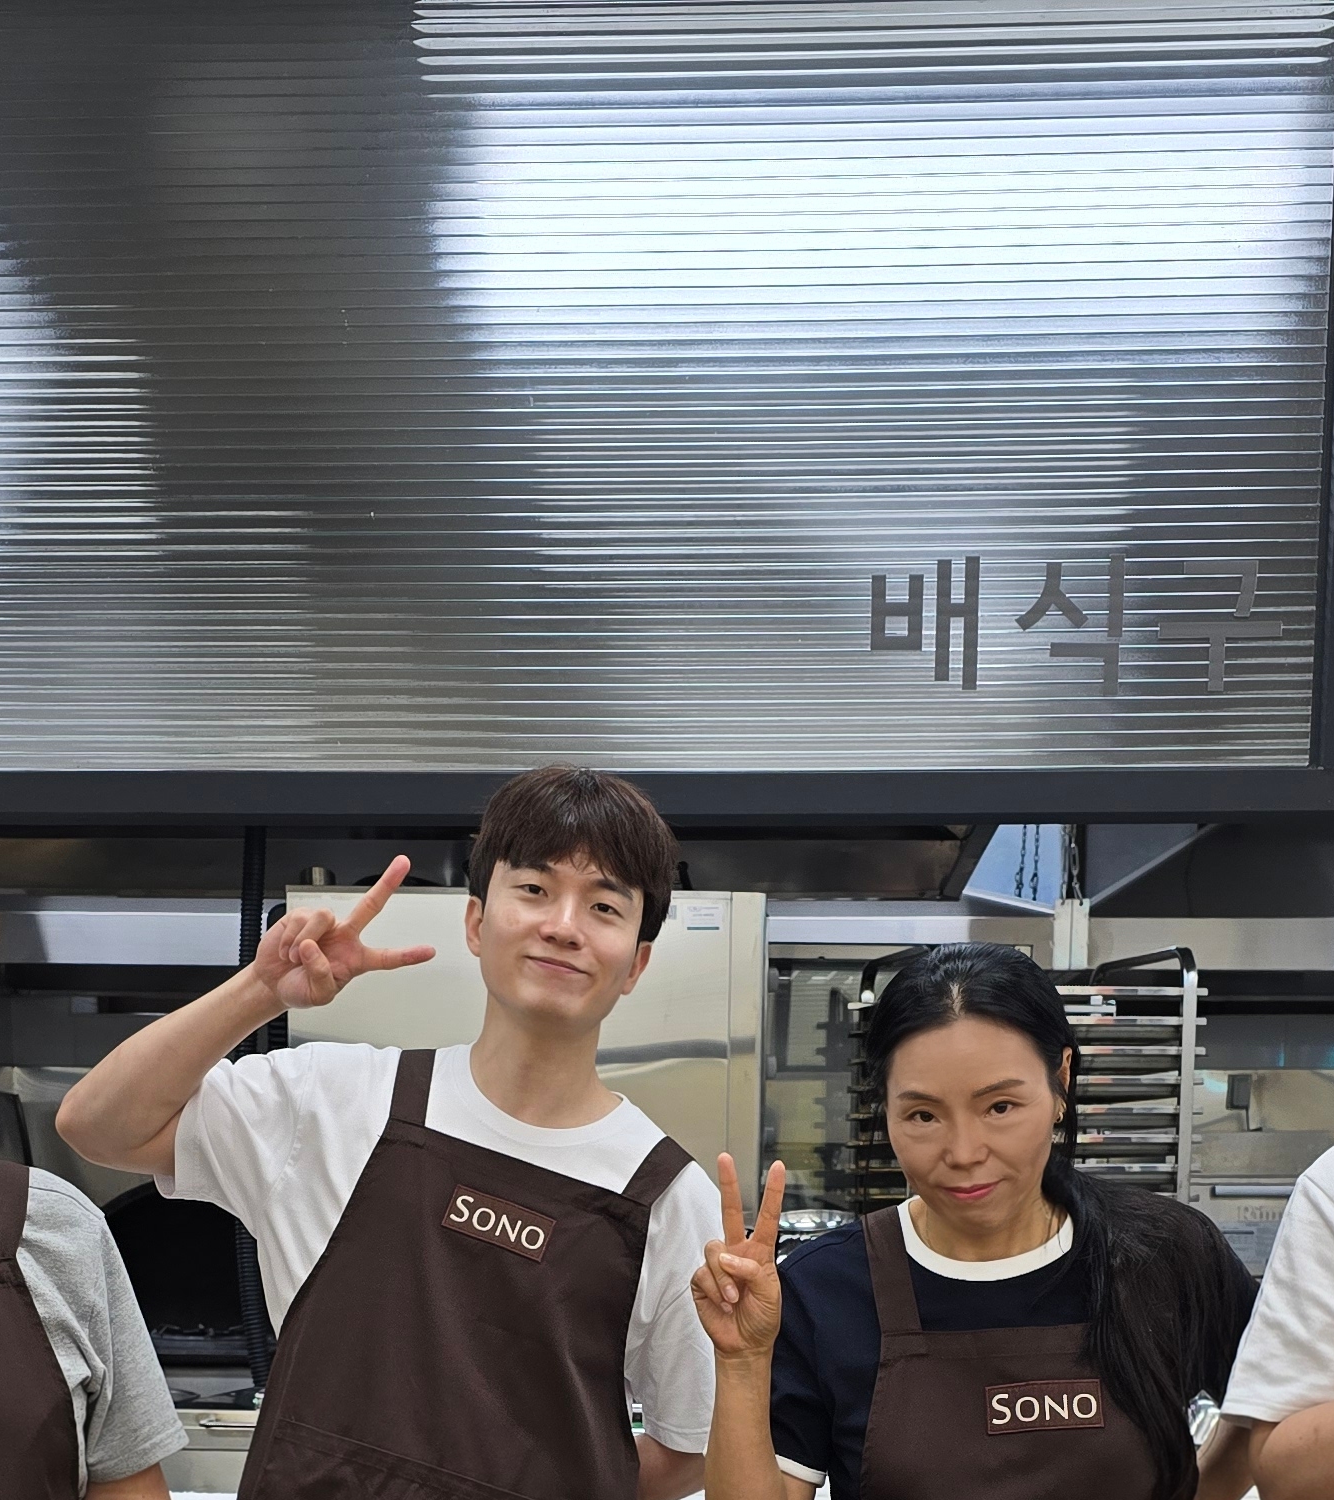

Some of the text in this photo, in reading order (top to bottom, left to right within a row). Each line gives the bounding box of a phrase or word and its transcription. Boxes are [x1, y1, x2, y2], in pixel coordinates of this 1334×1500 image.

[870, 554, 1284, 696] 배식구
[449, 1195, 545, 1250] SONO
[991, 1393, 1097, 1425] SONO
